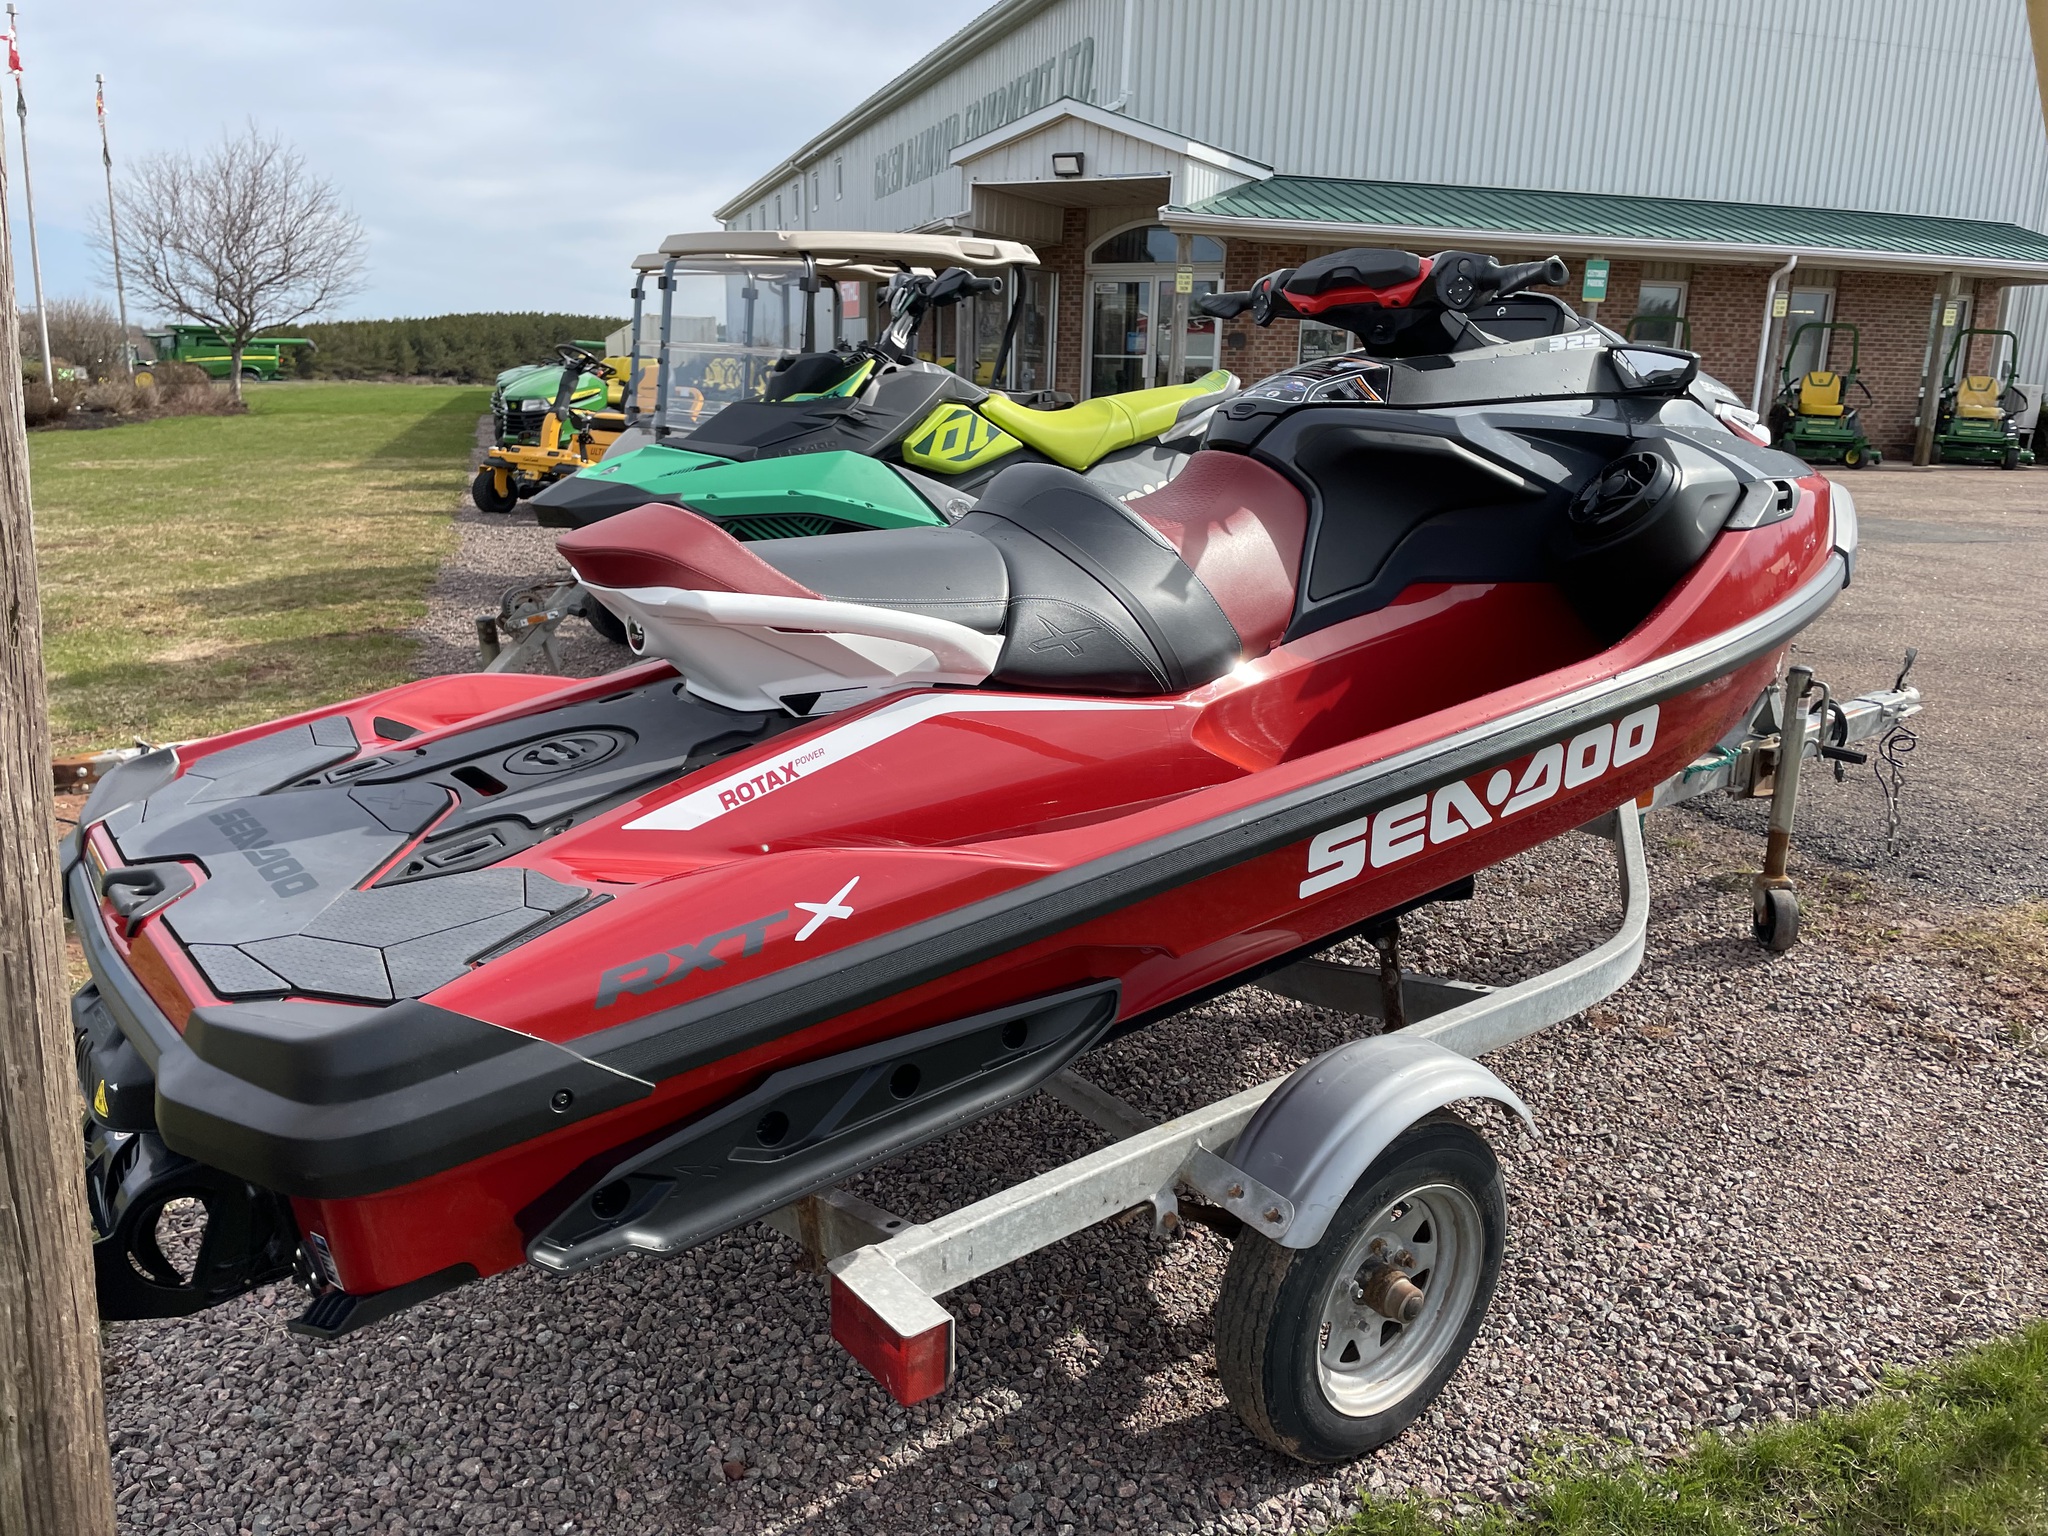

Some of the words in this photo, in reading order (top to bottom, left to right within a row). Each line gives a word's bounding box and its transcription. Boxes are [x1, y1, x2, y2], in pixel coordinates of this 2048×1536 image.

[874, 142, 904, 201] GREEN
[1549, 333, 1601, 352] 325
[718, 761, 801, 811] ROTAX
[795, 747, 826, 768] POWER
[595, 910, 789, 1010] RXT
[793, 875, 861, 942] X
